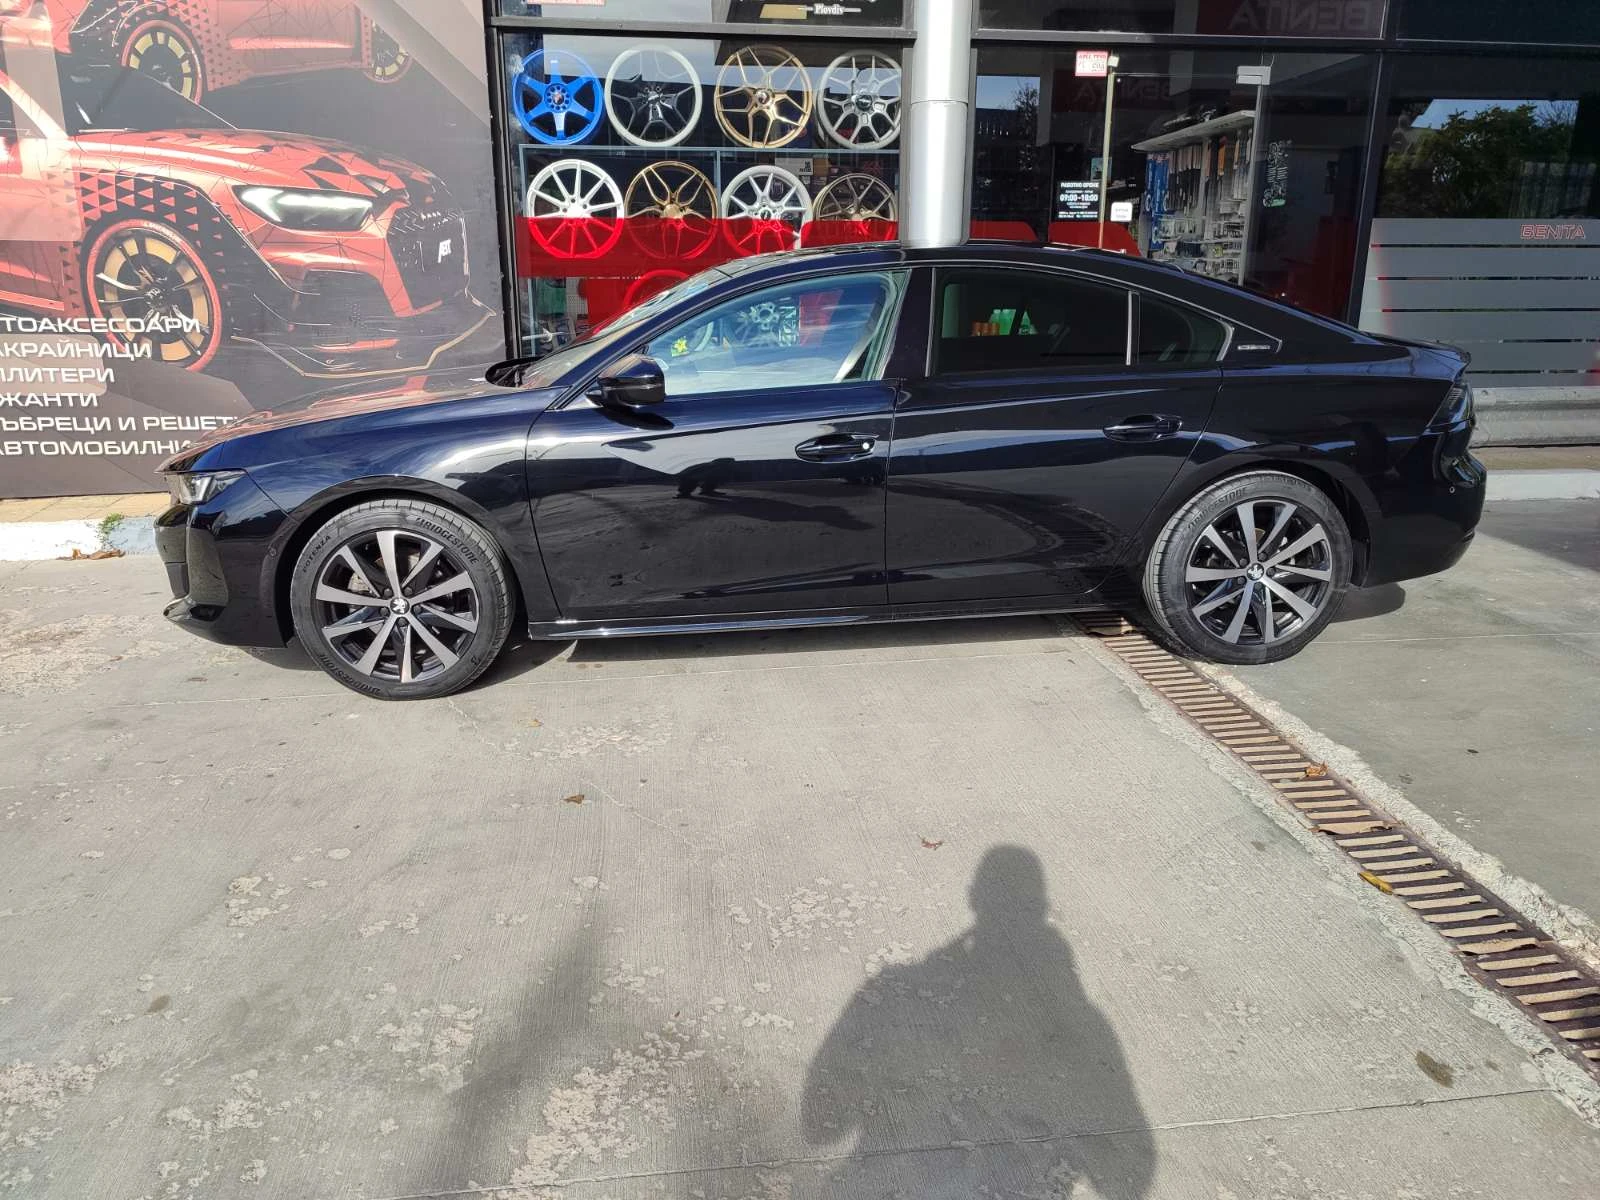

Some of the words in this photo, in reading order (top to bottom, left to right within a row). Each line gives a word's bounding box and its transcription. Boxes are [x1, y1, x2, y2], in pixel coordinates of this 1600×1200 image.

[1520, 224, 1586, 240] BENITA
[0, 340, 152, 361] КРАЙНИЦИ
[118, 417, 136, 431] И
[143, 416, 238, 431] РЕШЕТ
[415, 516, 480, 565] BRIDGESTONE
[303, 534, 331, 574] POTENZA
